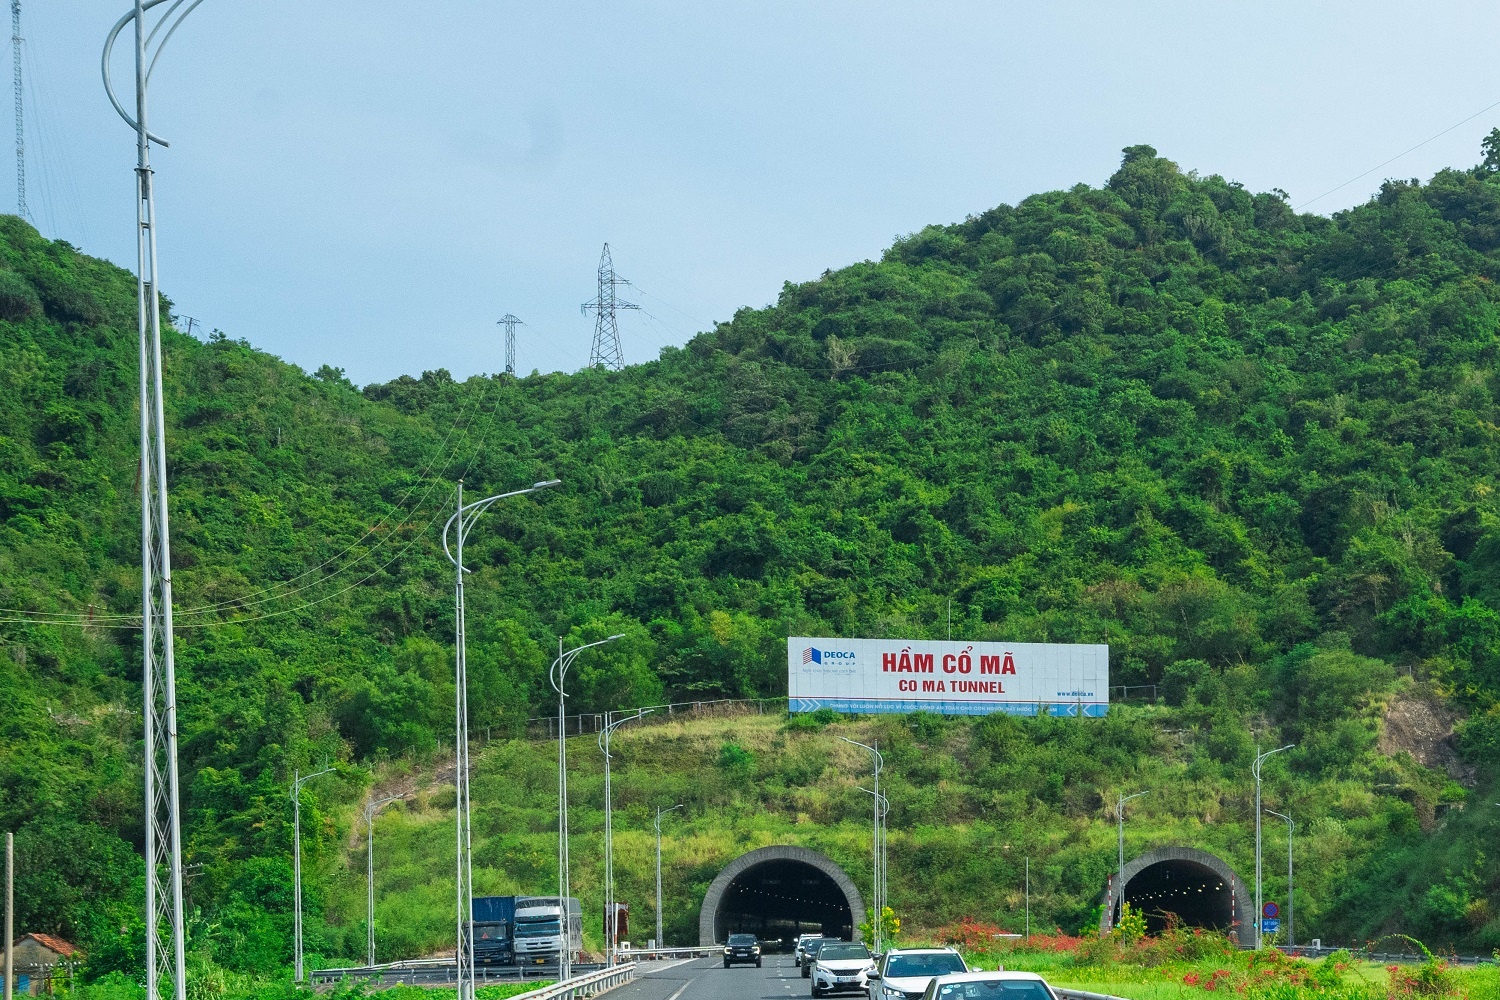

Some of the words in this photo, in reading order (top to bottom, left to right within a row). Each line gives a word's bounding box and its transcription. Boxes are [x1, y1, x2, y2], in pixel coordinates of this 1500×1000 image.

[824, 651, 856, 659] DEOCA
[882, 646, 934, 673] HẦM
[942, 645, 973, 674] CỔ
[980, 651, 1016, 675] MÃ
[898, 679, 918, 692] CO
[922, 680, 946, 692] MA
[949, 680, 1006, 693] TUNNEL
